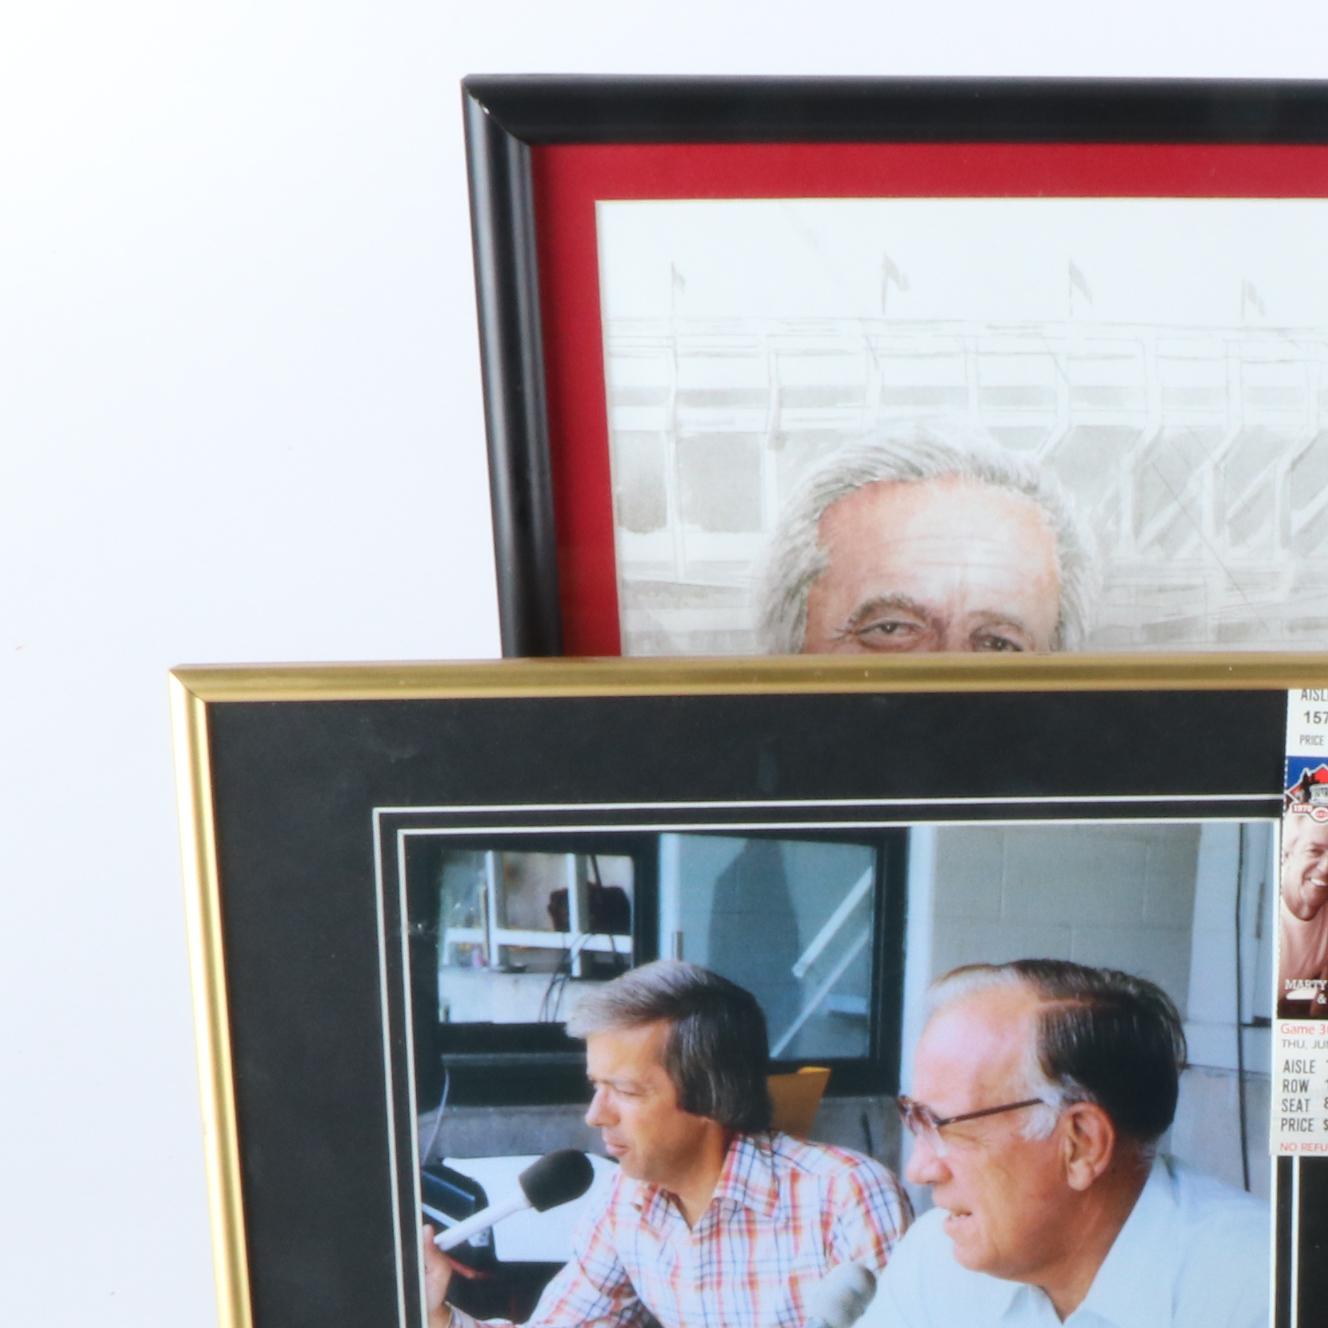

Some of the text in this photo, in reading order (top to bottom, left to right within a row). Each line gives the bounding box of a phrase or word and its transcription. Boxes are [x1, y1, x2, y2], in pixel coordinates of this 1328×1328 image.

[1300, 735, 1324, 746] PRICE
[1285, 979, 1327, 990] MARTY
[1317, 995, 1326, 1005] &
[1280, 1024, 1315, 1035] Game
[1283, 1059, 1316, 1074] AISLE
[1282, 1079, 1309, 1093] ROW
[1281, 1099, 1311, 1113] SEAT
[1280, 1118, 1314, 1132] PRICE
[1280, 1143, 1297, 1153] NO
